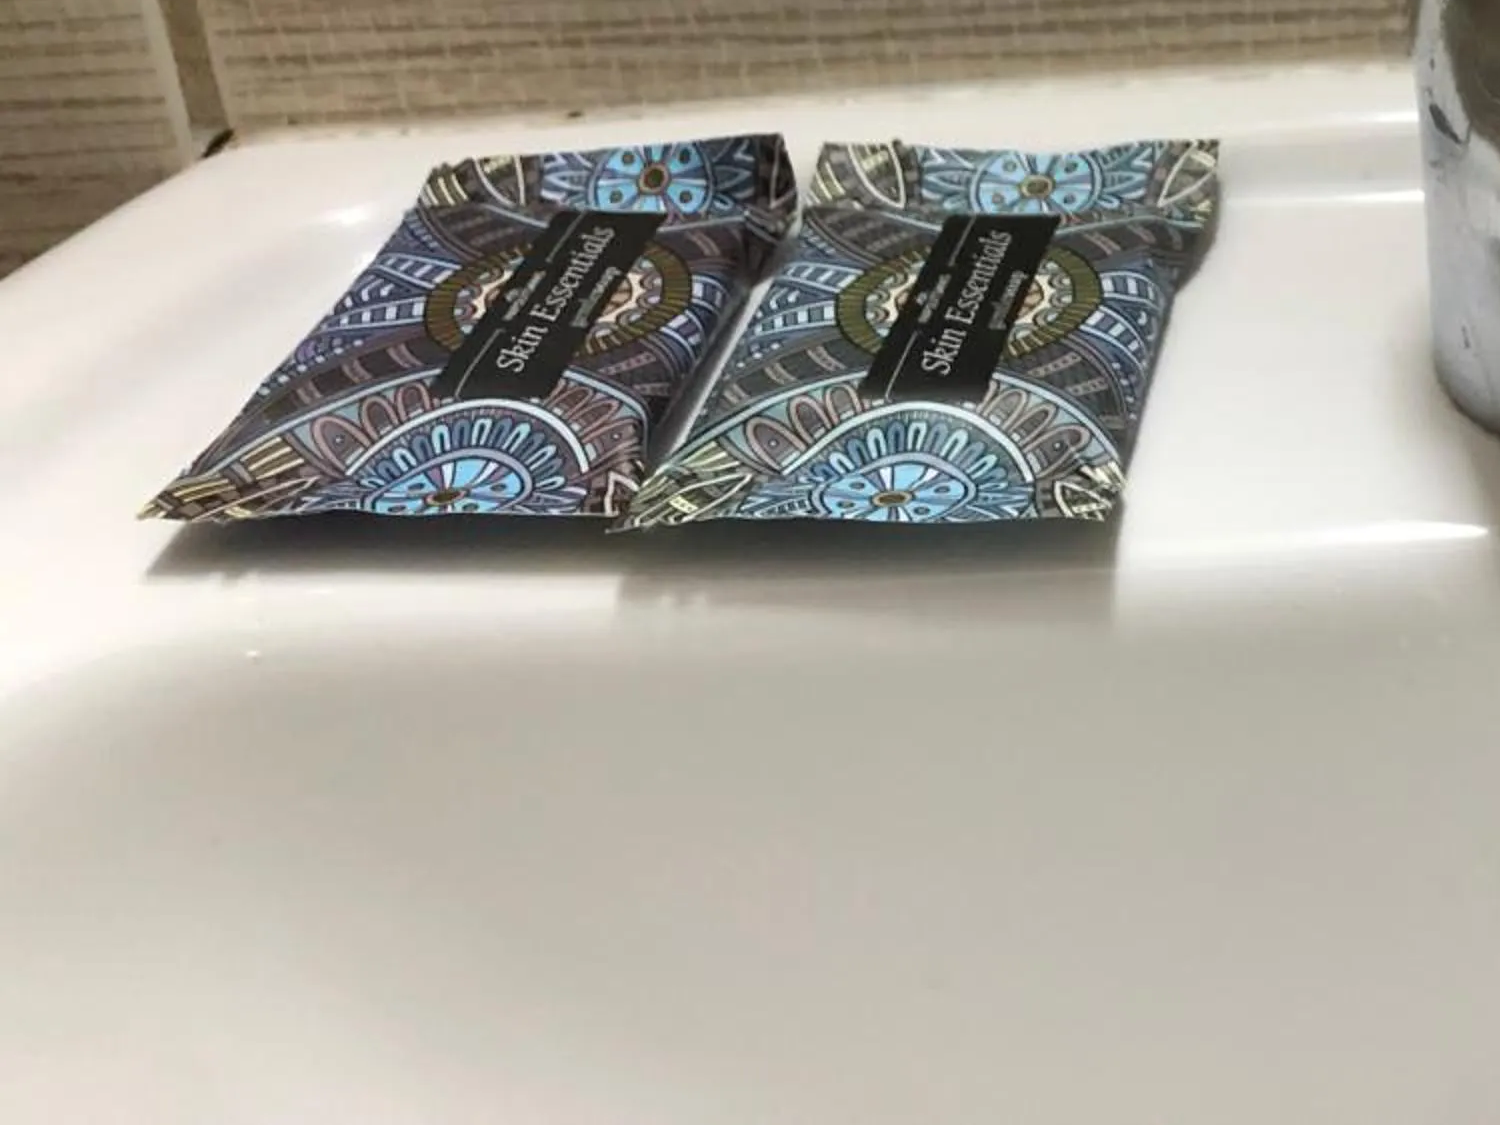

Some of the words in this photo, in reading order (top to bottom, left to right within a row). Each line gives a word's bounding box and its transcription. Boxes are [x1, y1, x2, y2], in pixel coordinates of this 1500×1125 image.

[496, 324, 549, 373] Skin
[530, 225, 615, 323] Essentials
[943, 229, 1013, 325] Essentials
[920, 327, 967, 376] Skin
